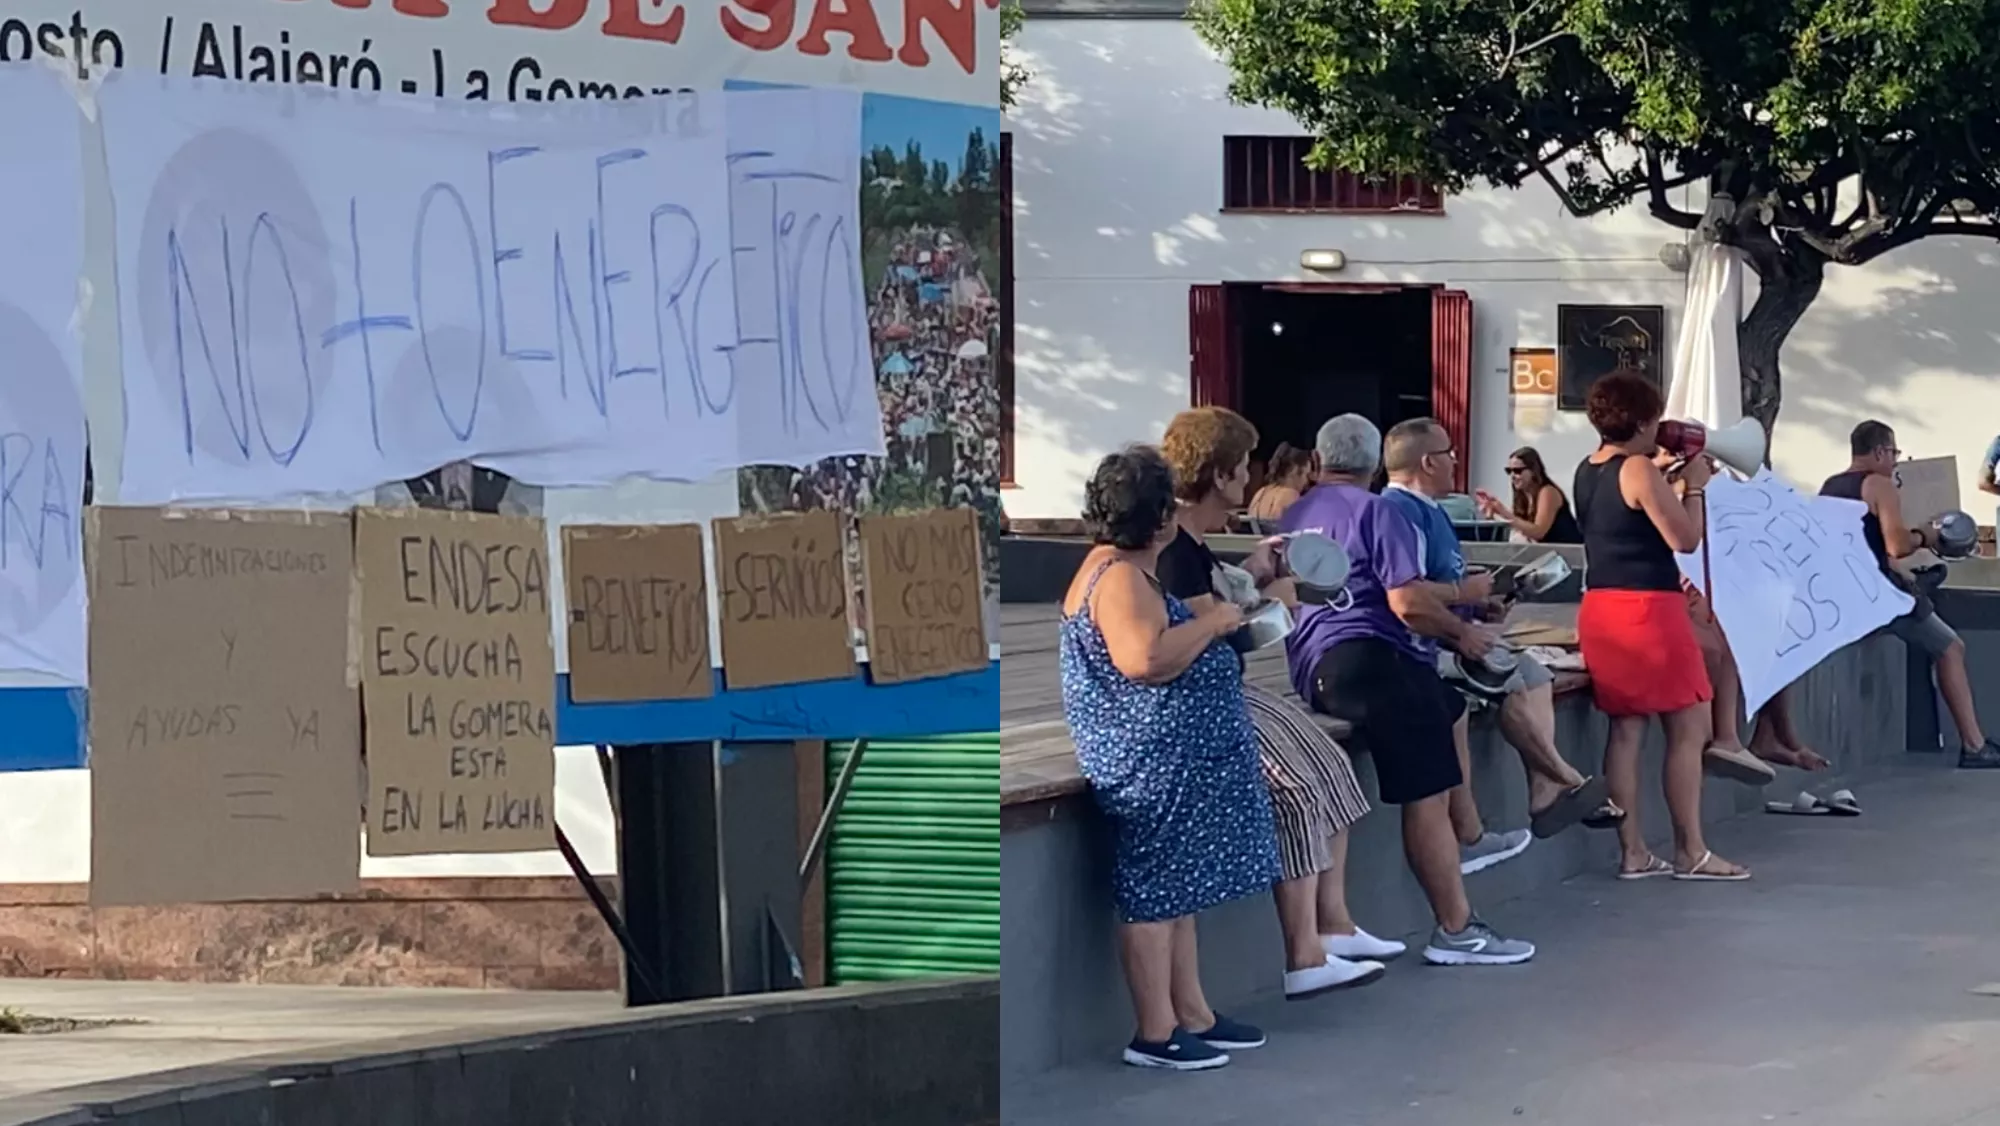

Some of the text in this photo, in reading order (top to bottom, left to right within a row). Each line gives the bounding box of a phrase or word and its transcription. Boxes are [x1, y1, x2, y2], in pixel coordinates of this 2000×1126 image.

[720, 0, 1000, 75] SAN
[168, 210, 313, 468] NO
[1512, 359, 1554, 391] Bc
[401, 535, 546, 615] ENDESA
[376, 626, 523, 683] ESCUCHA
[126, 703, 321, 751] AYUDAS YA
[407, 692, 552, 741] LA GOMERA
[451, 746, 507, 778] ESTA
[382, 786, 545, 834] EN LA LUCHA
